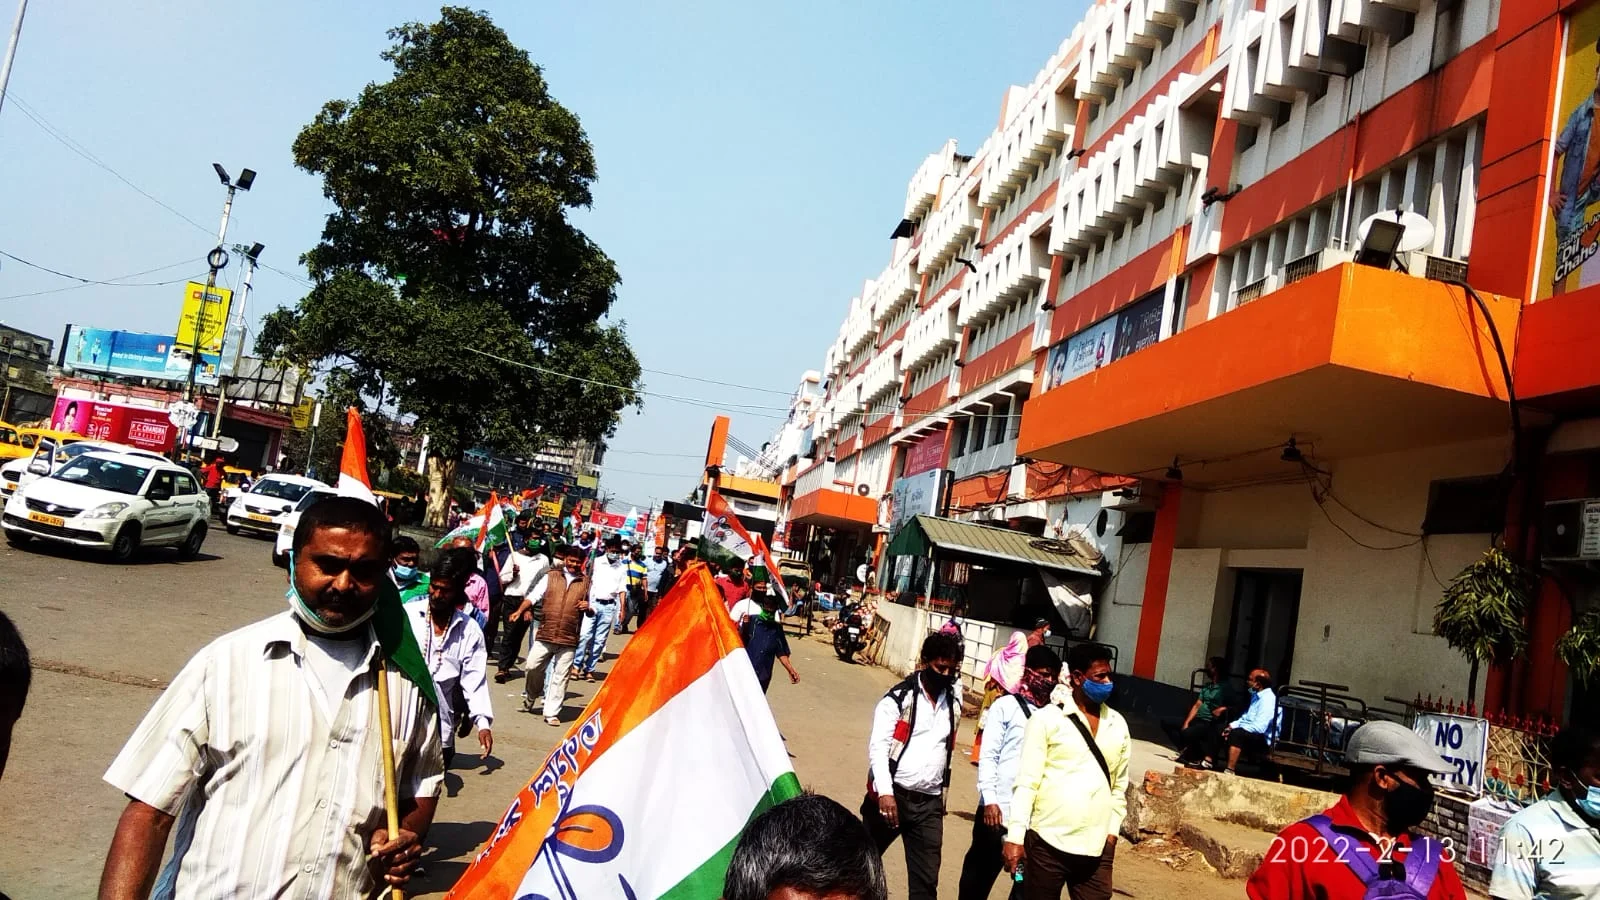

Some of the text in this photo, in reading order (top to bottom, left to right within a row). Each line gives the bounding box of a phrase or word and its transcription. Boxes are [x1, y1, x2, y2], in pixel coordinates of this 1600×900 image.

[1562, 237, 1580, 264] Dil
[142, 424, 165, 435] CHANDRA
[1435, 721, 1463, 750] NO
